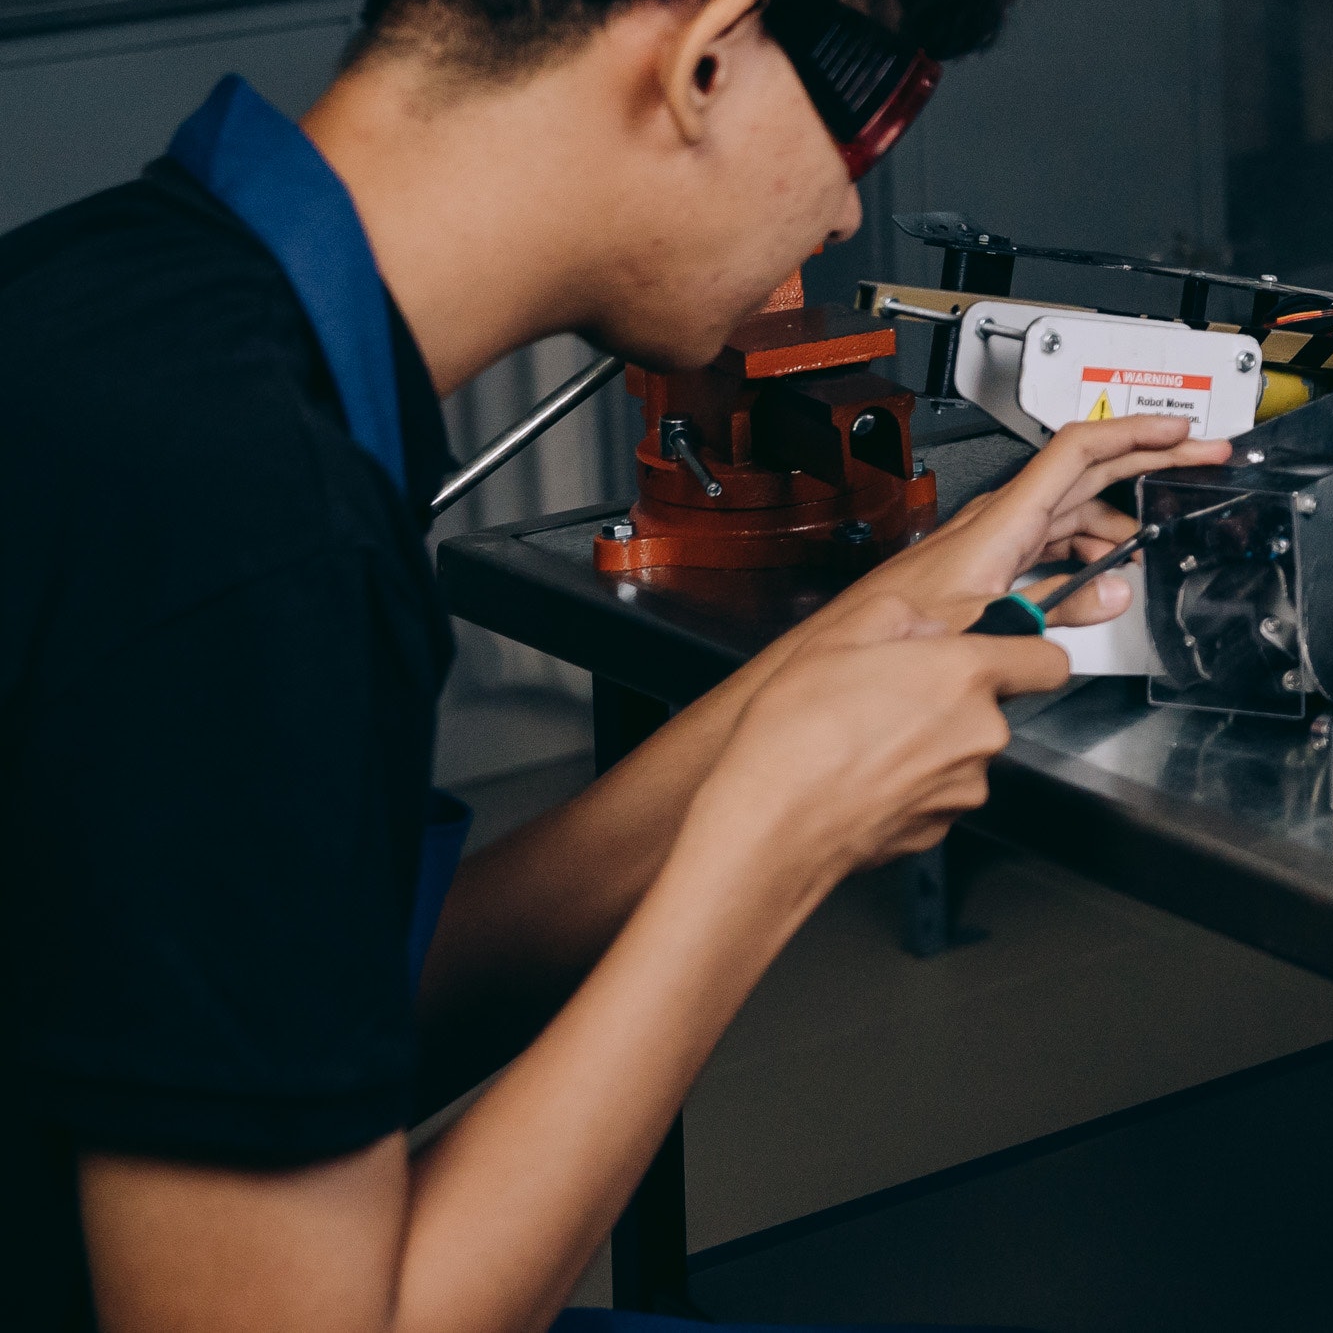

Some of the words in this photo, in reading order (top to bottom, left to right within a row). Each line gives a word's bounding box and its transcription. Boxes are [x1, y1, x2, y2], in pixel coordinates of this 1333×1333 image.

[1122, 372, 1184, 388] WARNING
[1137, 396, 1164, 407] Robot
[1166, 398, 1195, 410] Moves
